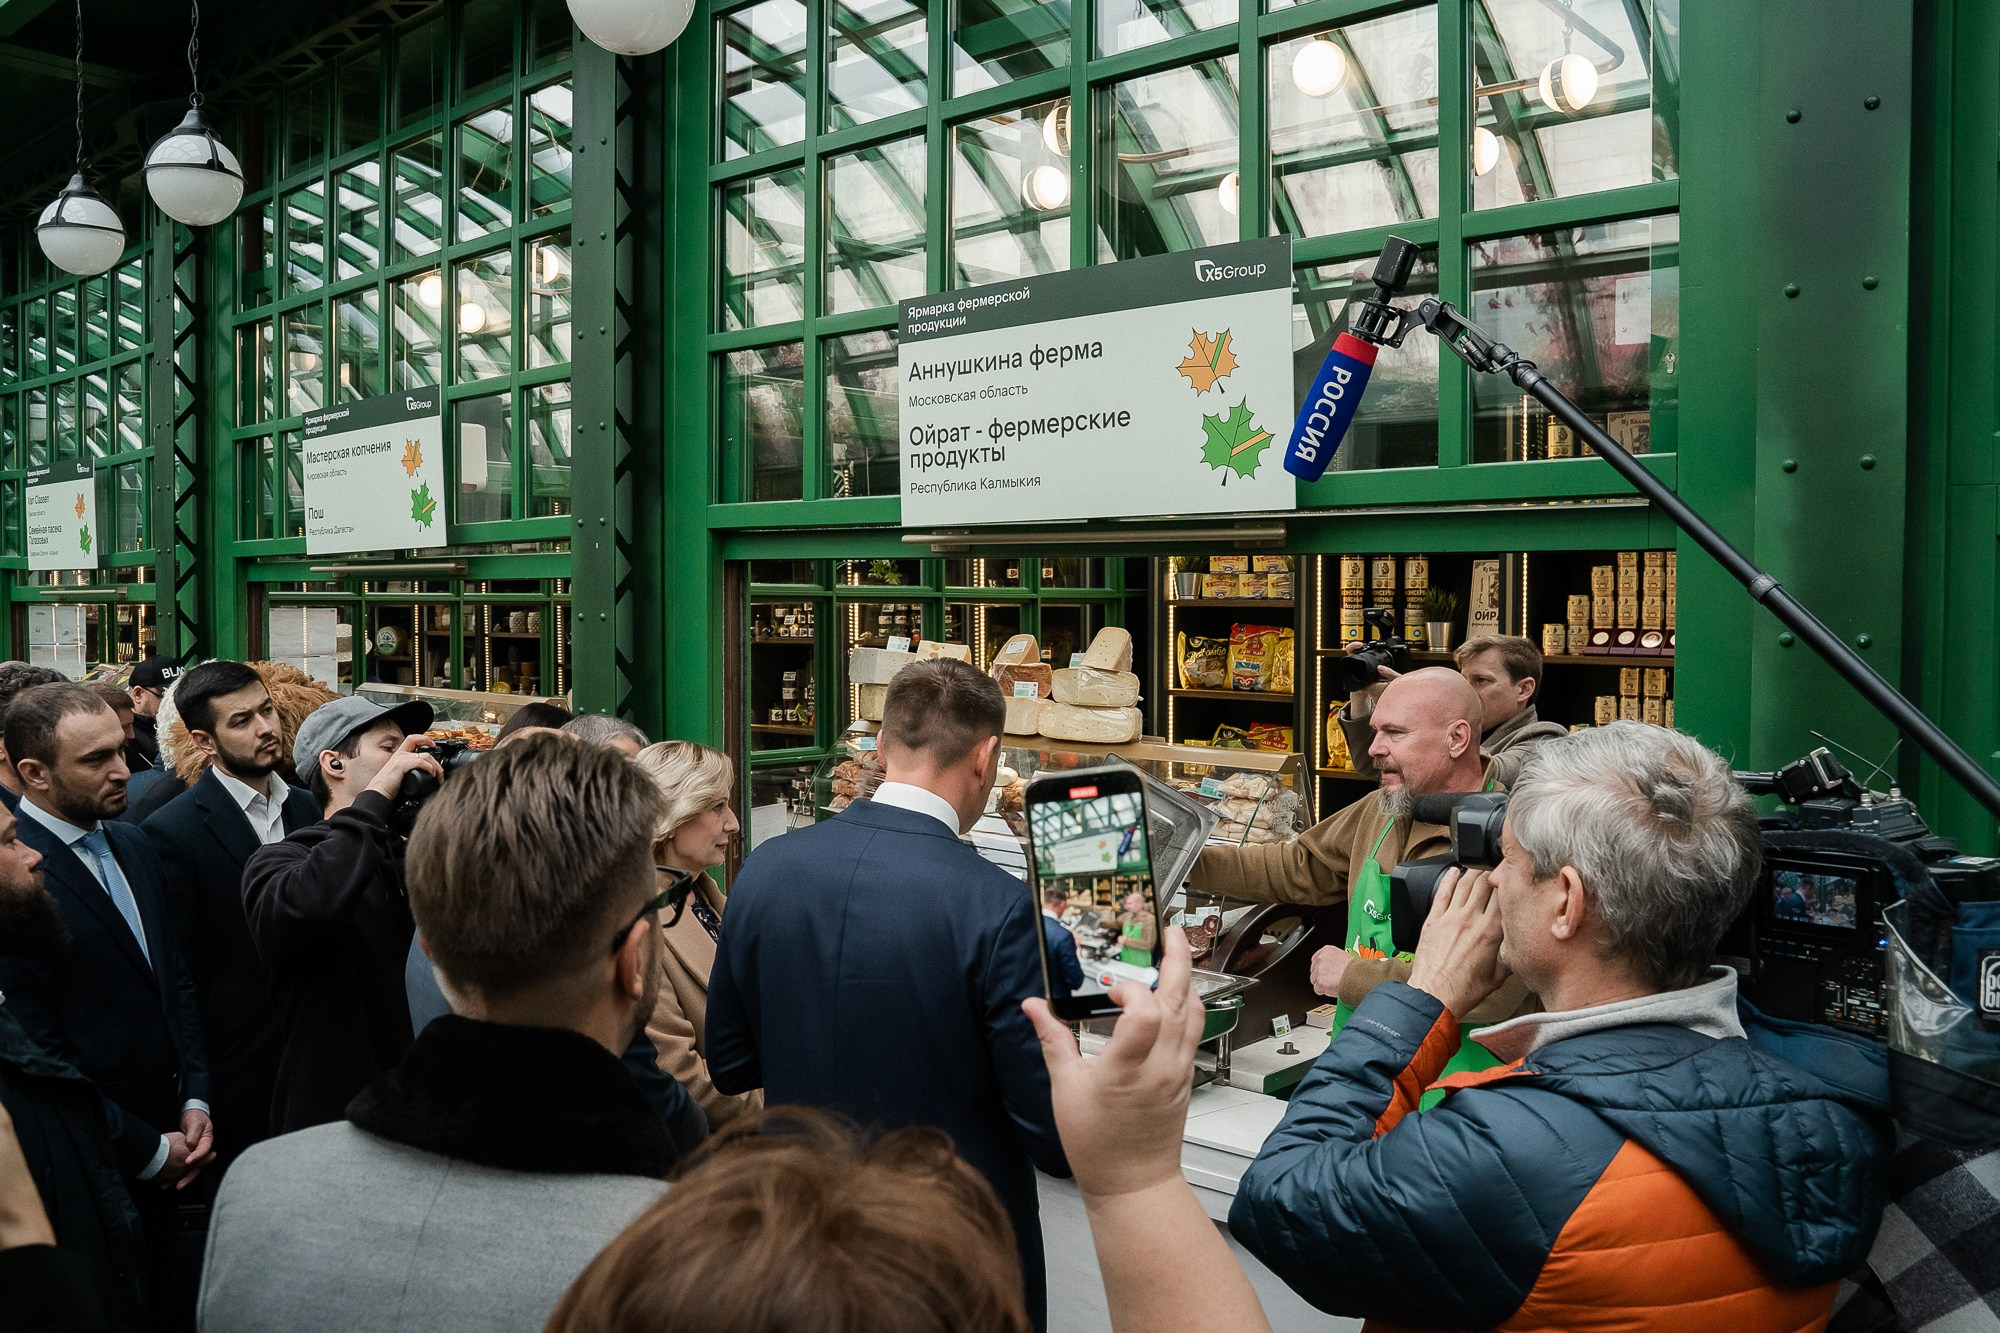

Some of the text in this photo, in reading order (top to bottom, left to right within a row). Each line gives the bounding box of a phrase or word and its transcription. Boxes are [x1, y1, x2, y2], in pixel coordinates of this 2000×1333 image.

[1205, 264, 1267, 282] X5Group
[907, 286, 1030, 320] Ярмарка фермерской
[908, 315, 967, 336] продукции
[908, 341, 1103, 382] Аннушкина ферма
[909, 385, 1029, 407] Московская область
[1294, 365, 1353, 463] РОССИЯ
[909, 423, 971, 449] Ойрат
[988, 410, 1131, 444] фермерские
[306, 440, 392, 465] Мастерская копчения
[910, 445, 1006, 472] продукты
[910, 477, 1041, 496] Республика Калмыкия
[308, 507, 324, 520] Пош
[1474, 608, 1499, 621] ОЙР
[161, 666, 186, 679] BLA
[1368, 906, 1392, 921] X5Gro
